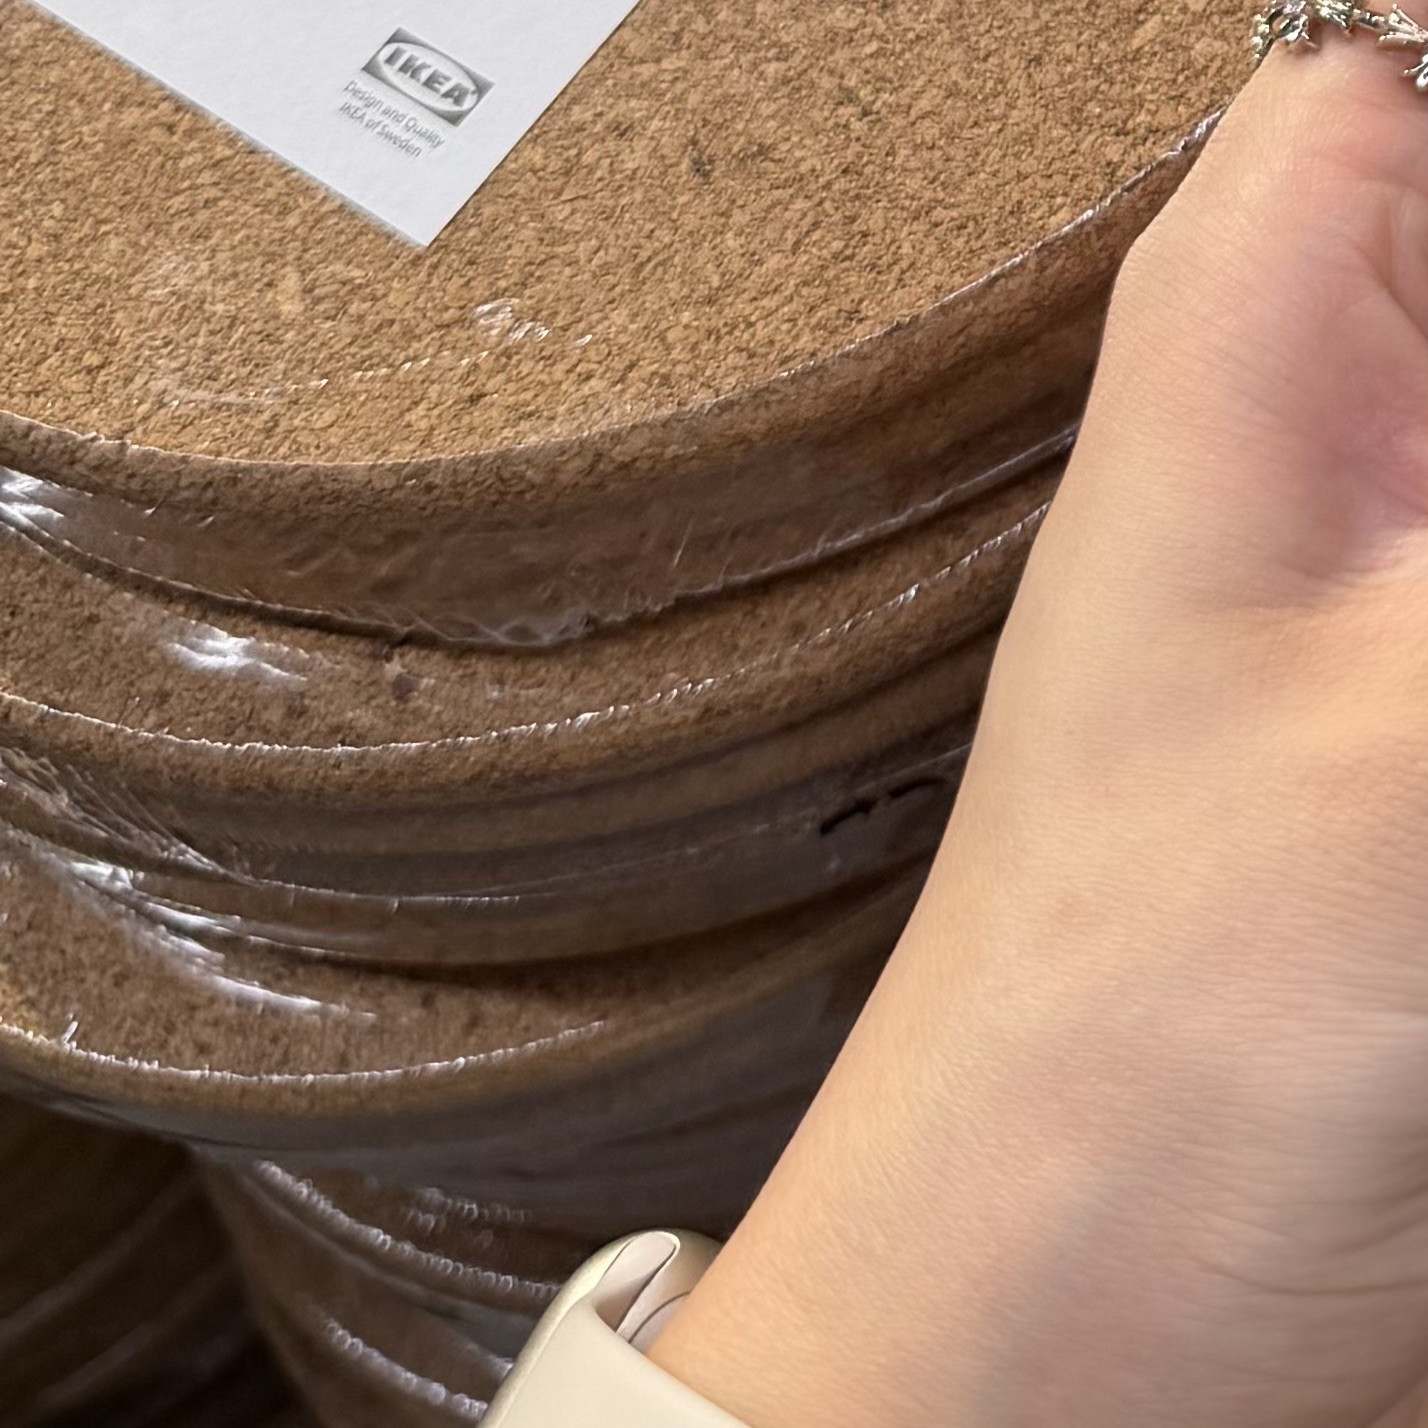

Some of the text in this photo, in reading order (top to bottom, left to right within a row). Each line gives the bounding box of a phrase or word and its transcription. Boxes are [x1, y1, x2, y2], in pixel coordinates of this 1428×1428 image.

[339, 102, 422, 158] IKEA of Sweden
[343, 80, 446, 150] Design and Quality
